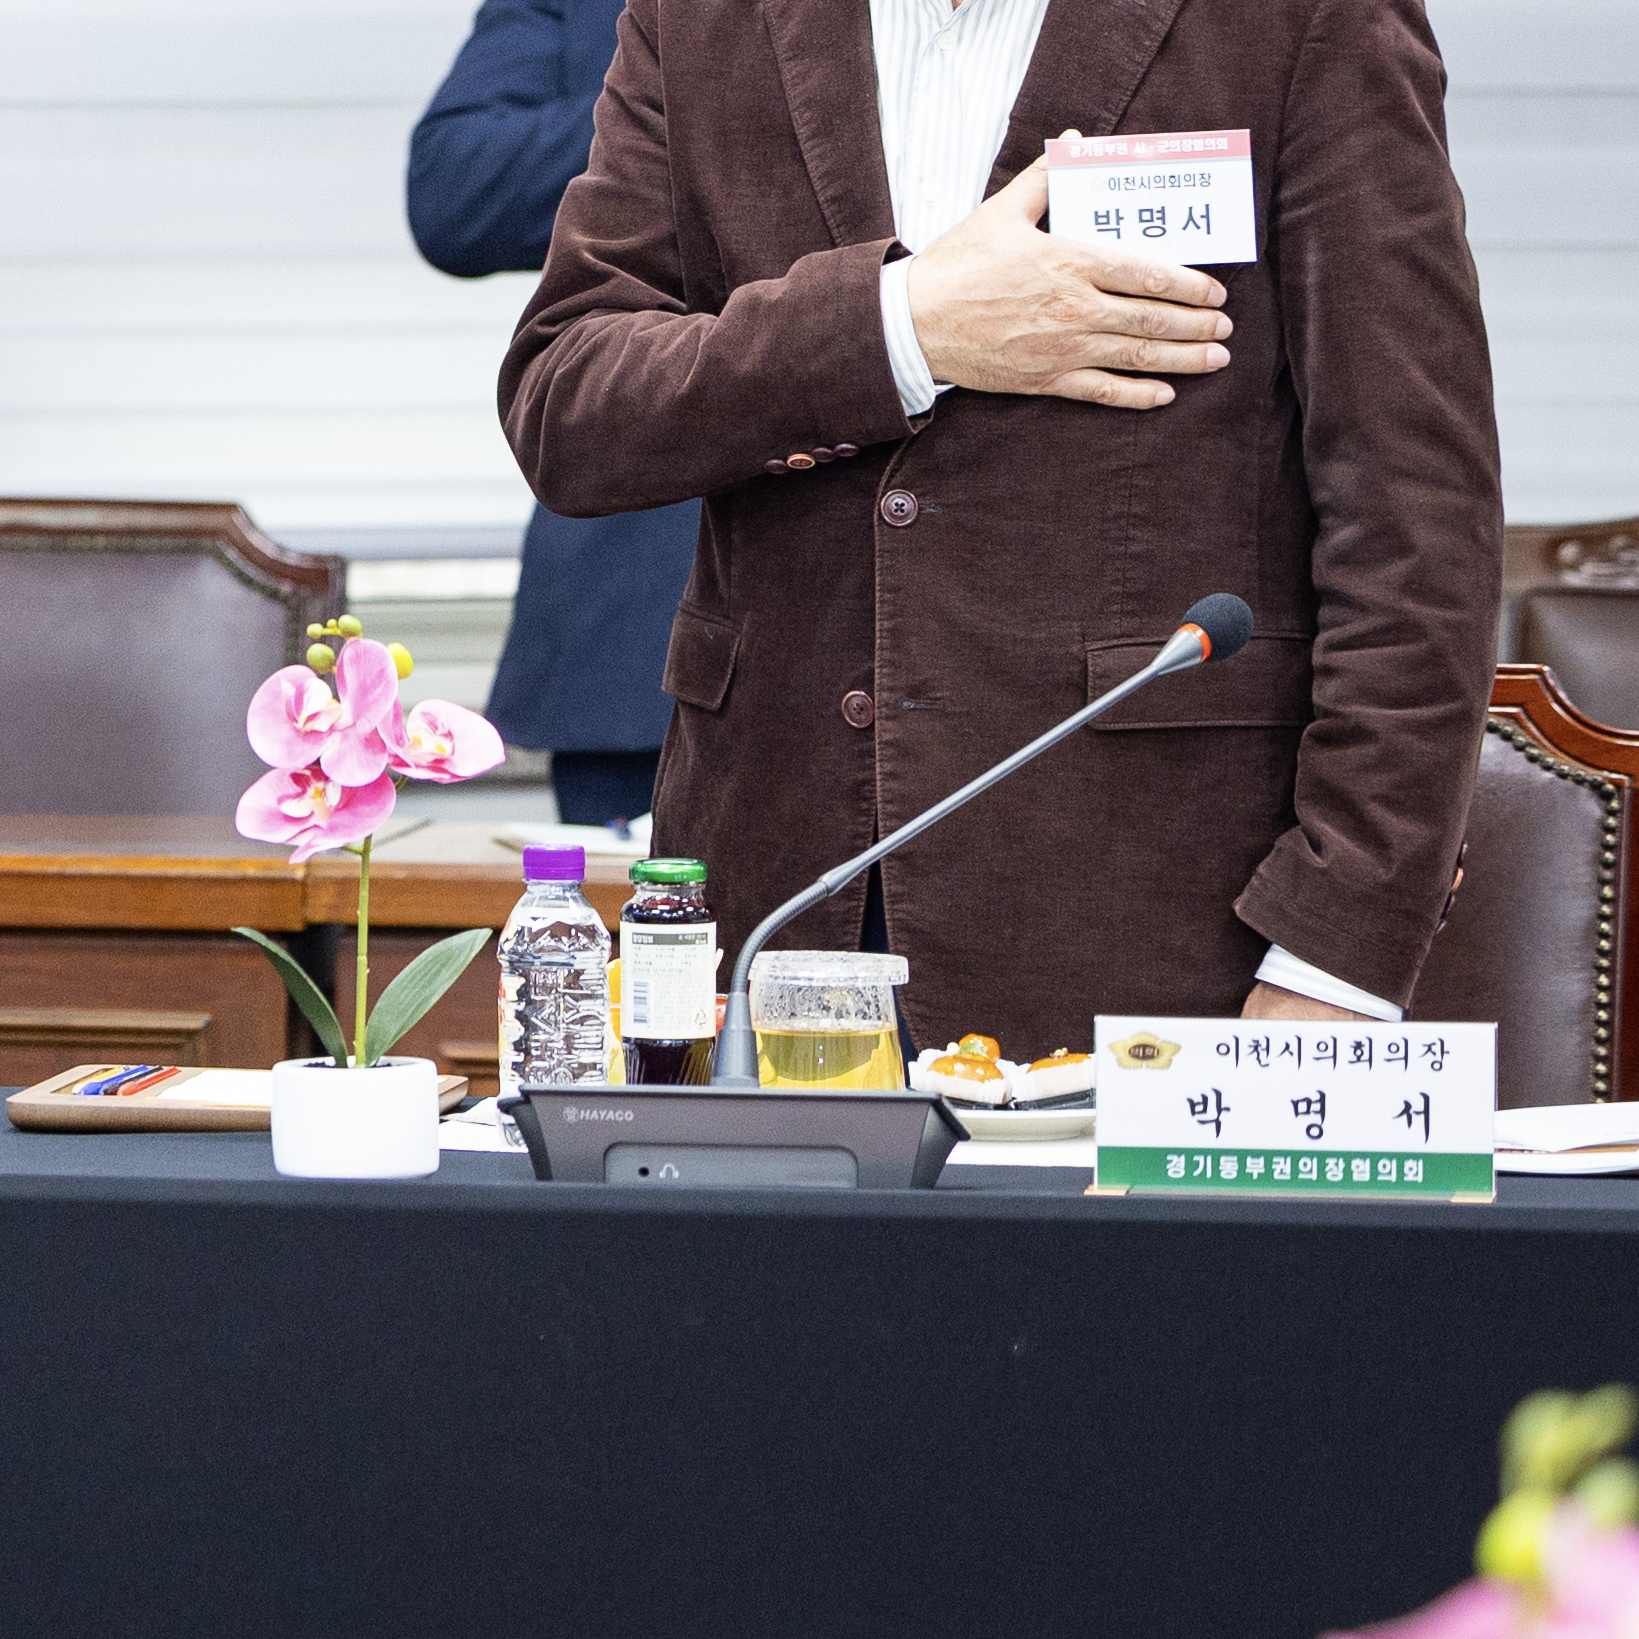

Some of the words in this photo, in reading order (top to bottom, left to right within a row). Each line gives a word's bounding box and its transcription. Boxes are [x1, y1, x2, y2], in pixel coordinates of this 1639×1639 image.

[1108, 172, 1212, 191] 이천시의회의장
[1215, 1035, 1450, 1072] 이천시의회의장
[579, 1109, 634, 1121] HAYACO
[1165, 1153, 1425, 1184] 경기동부권의장협의회
